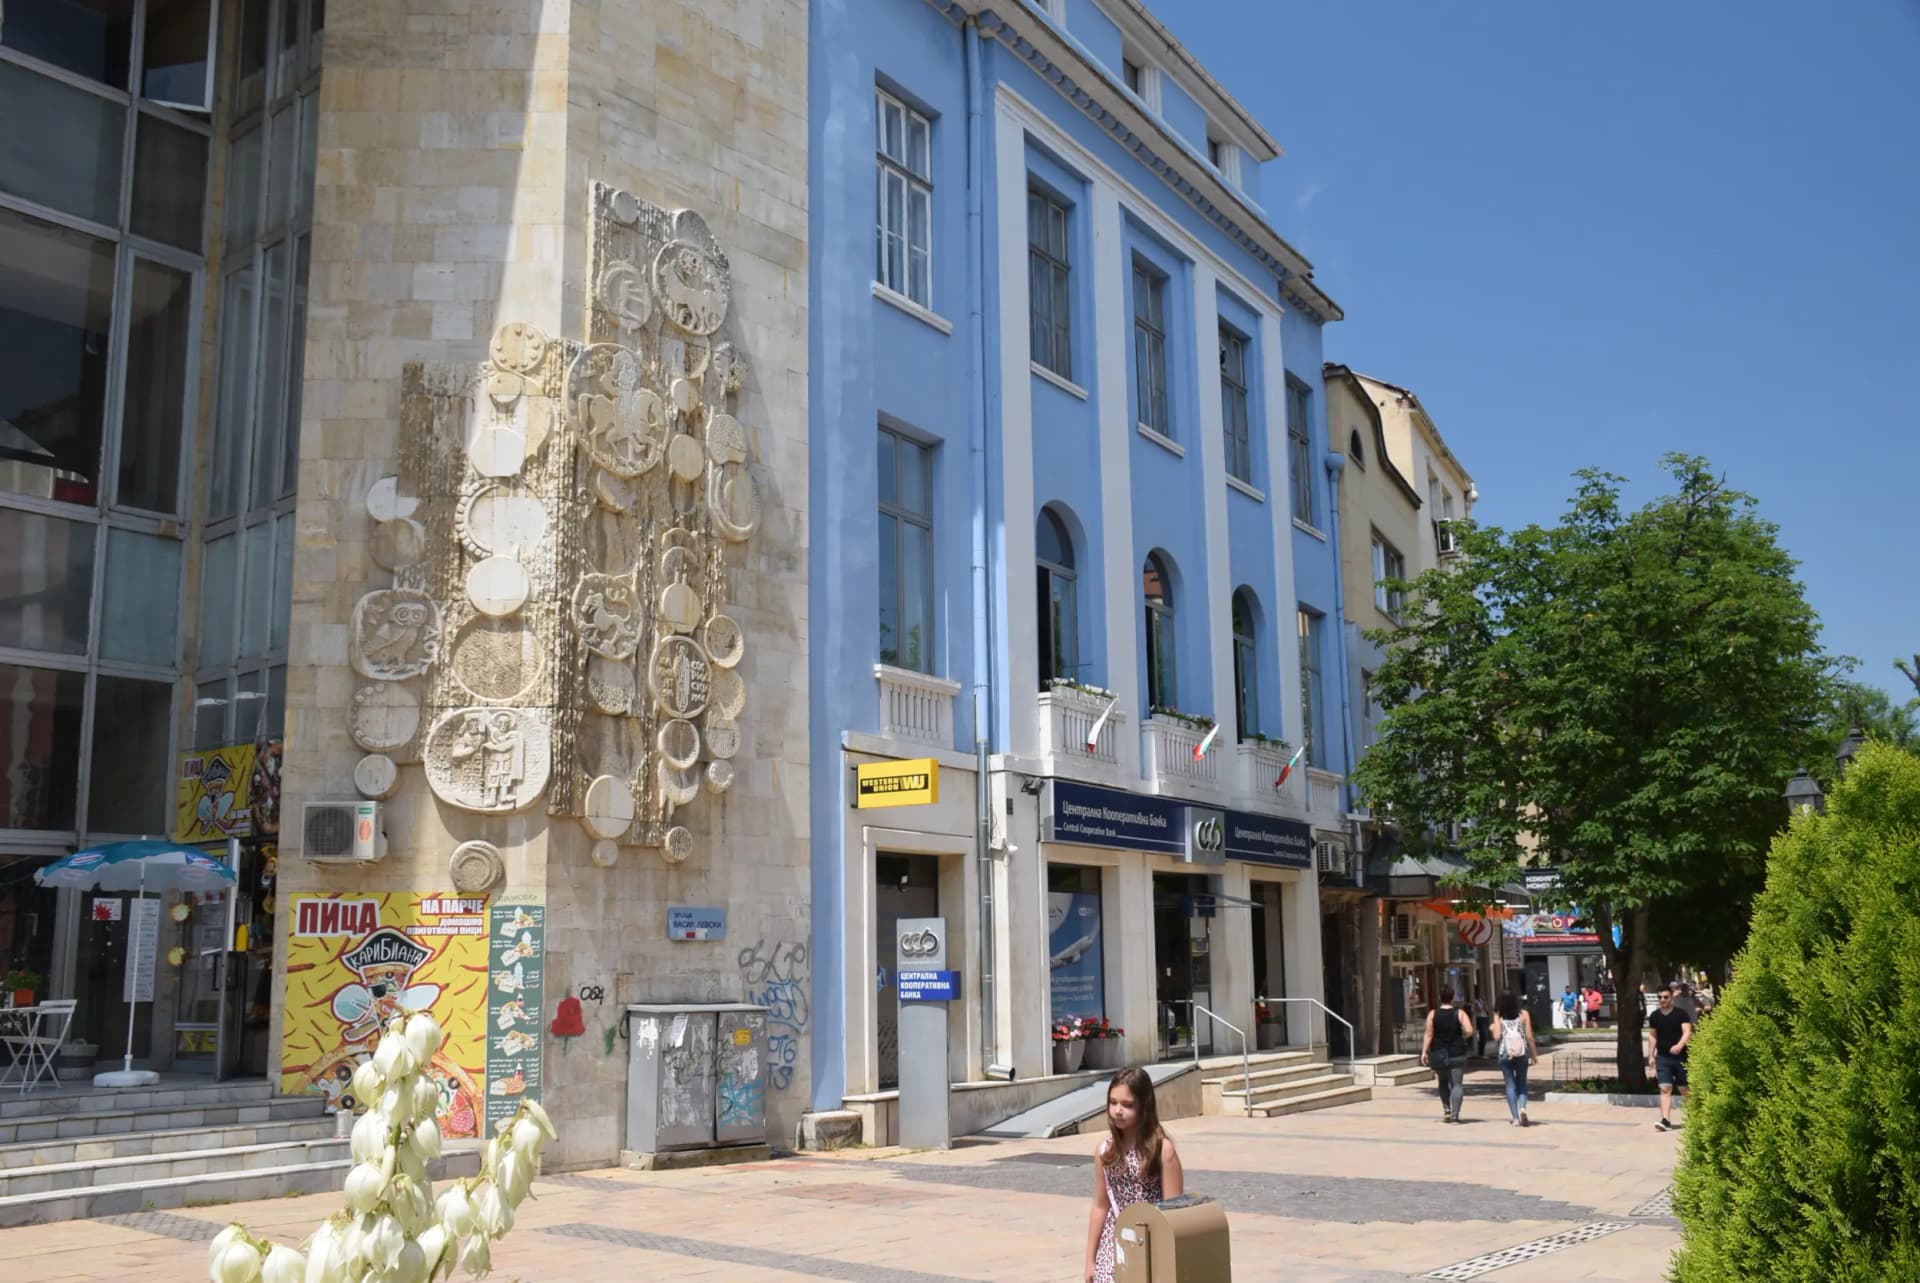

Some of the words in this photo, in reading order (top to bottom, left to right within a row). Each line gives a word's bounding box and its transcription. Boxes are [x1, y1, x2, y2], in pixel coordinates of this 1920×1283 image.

[862, 777, 899, 787] WESTERN
[873, 784, 899, 793] UNION
[1062, 800, 1102, 820] Централна
[1103, 806, 1149, 827] Кооперативна
[1150, 813, 1167, 828] Банка
[1063, 821, 1079, 831] Central
[1106, 827, 1117, 837] Bank
[422, 899, 439, 914] НА
[442, 899, 484, 914] ПАРЧЕ
[299, 902, 377, 935] ПИЦА
[350, 938, 423, 968] КАРИБИАНА
[900, 972, 938, 981] ЦЕНТРАЛНА
[900, 981, 951, 990] КООПЕРАТИВНА
[900, 991, 921, 999] БАНКА
